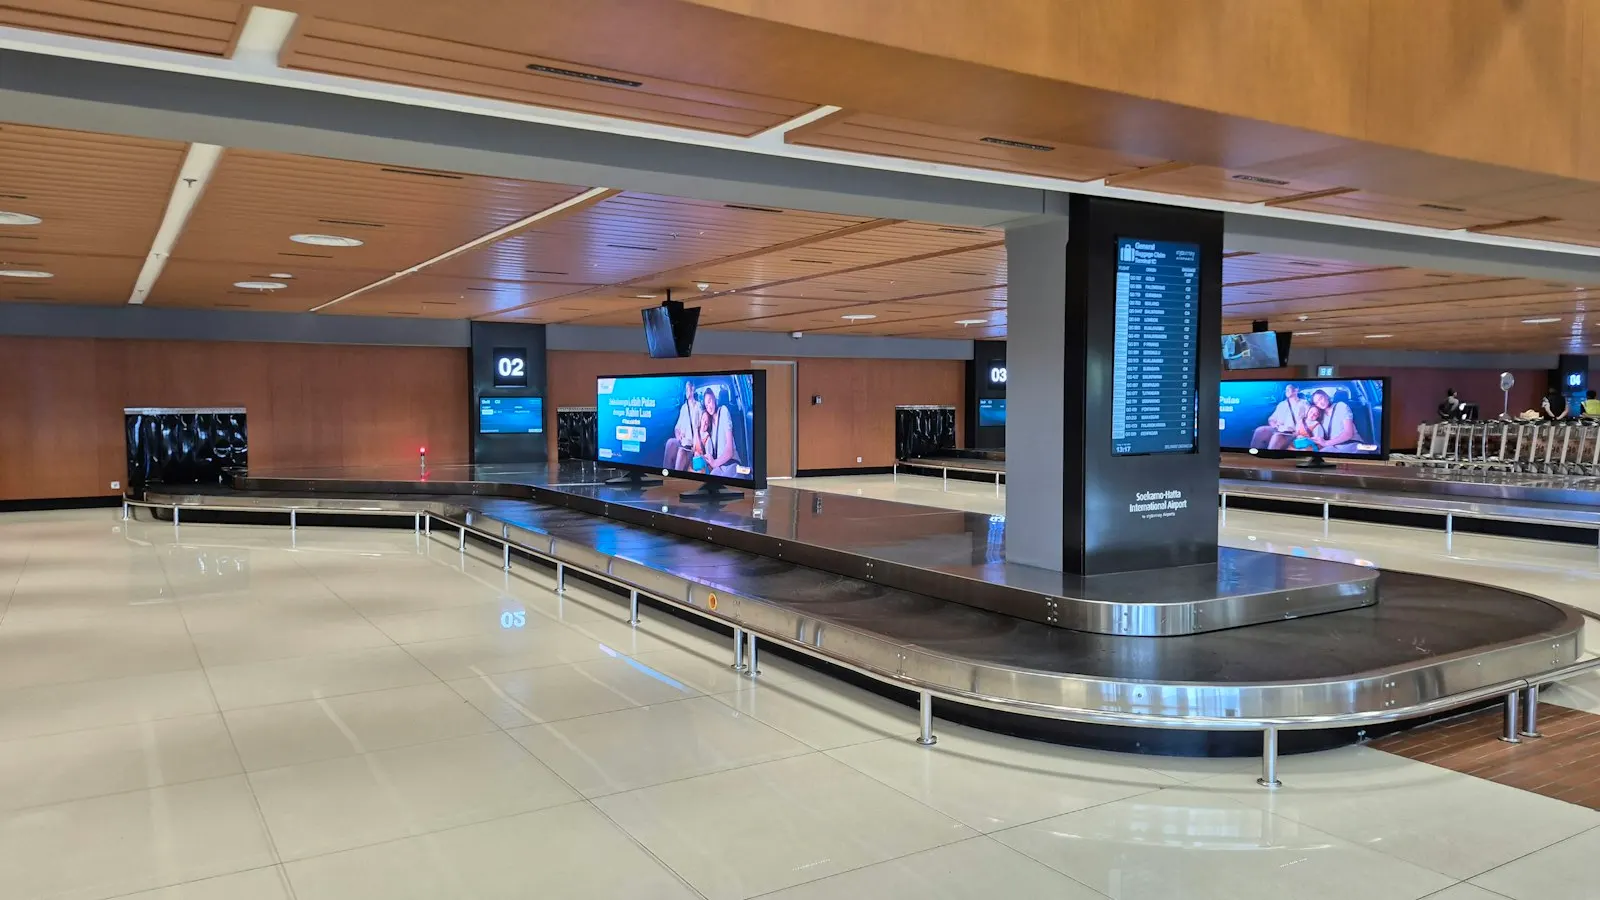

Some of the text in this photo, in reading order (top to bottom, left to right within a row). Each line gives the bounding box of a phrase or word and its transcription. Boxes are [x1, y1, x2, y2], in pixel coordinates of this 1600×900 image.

[498, 357, 524, 377] 02
[991, 367, 1007, 383] 03
[1570, 374, 1581, 385] 04
[1136, 490, 1182, 501] Soekarno-Hatta
[1129, 499, 1187, 513] International Airport
